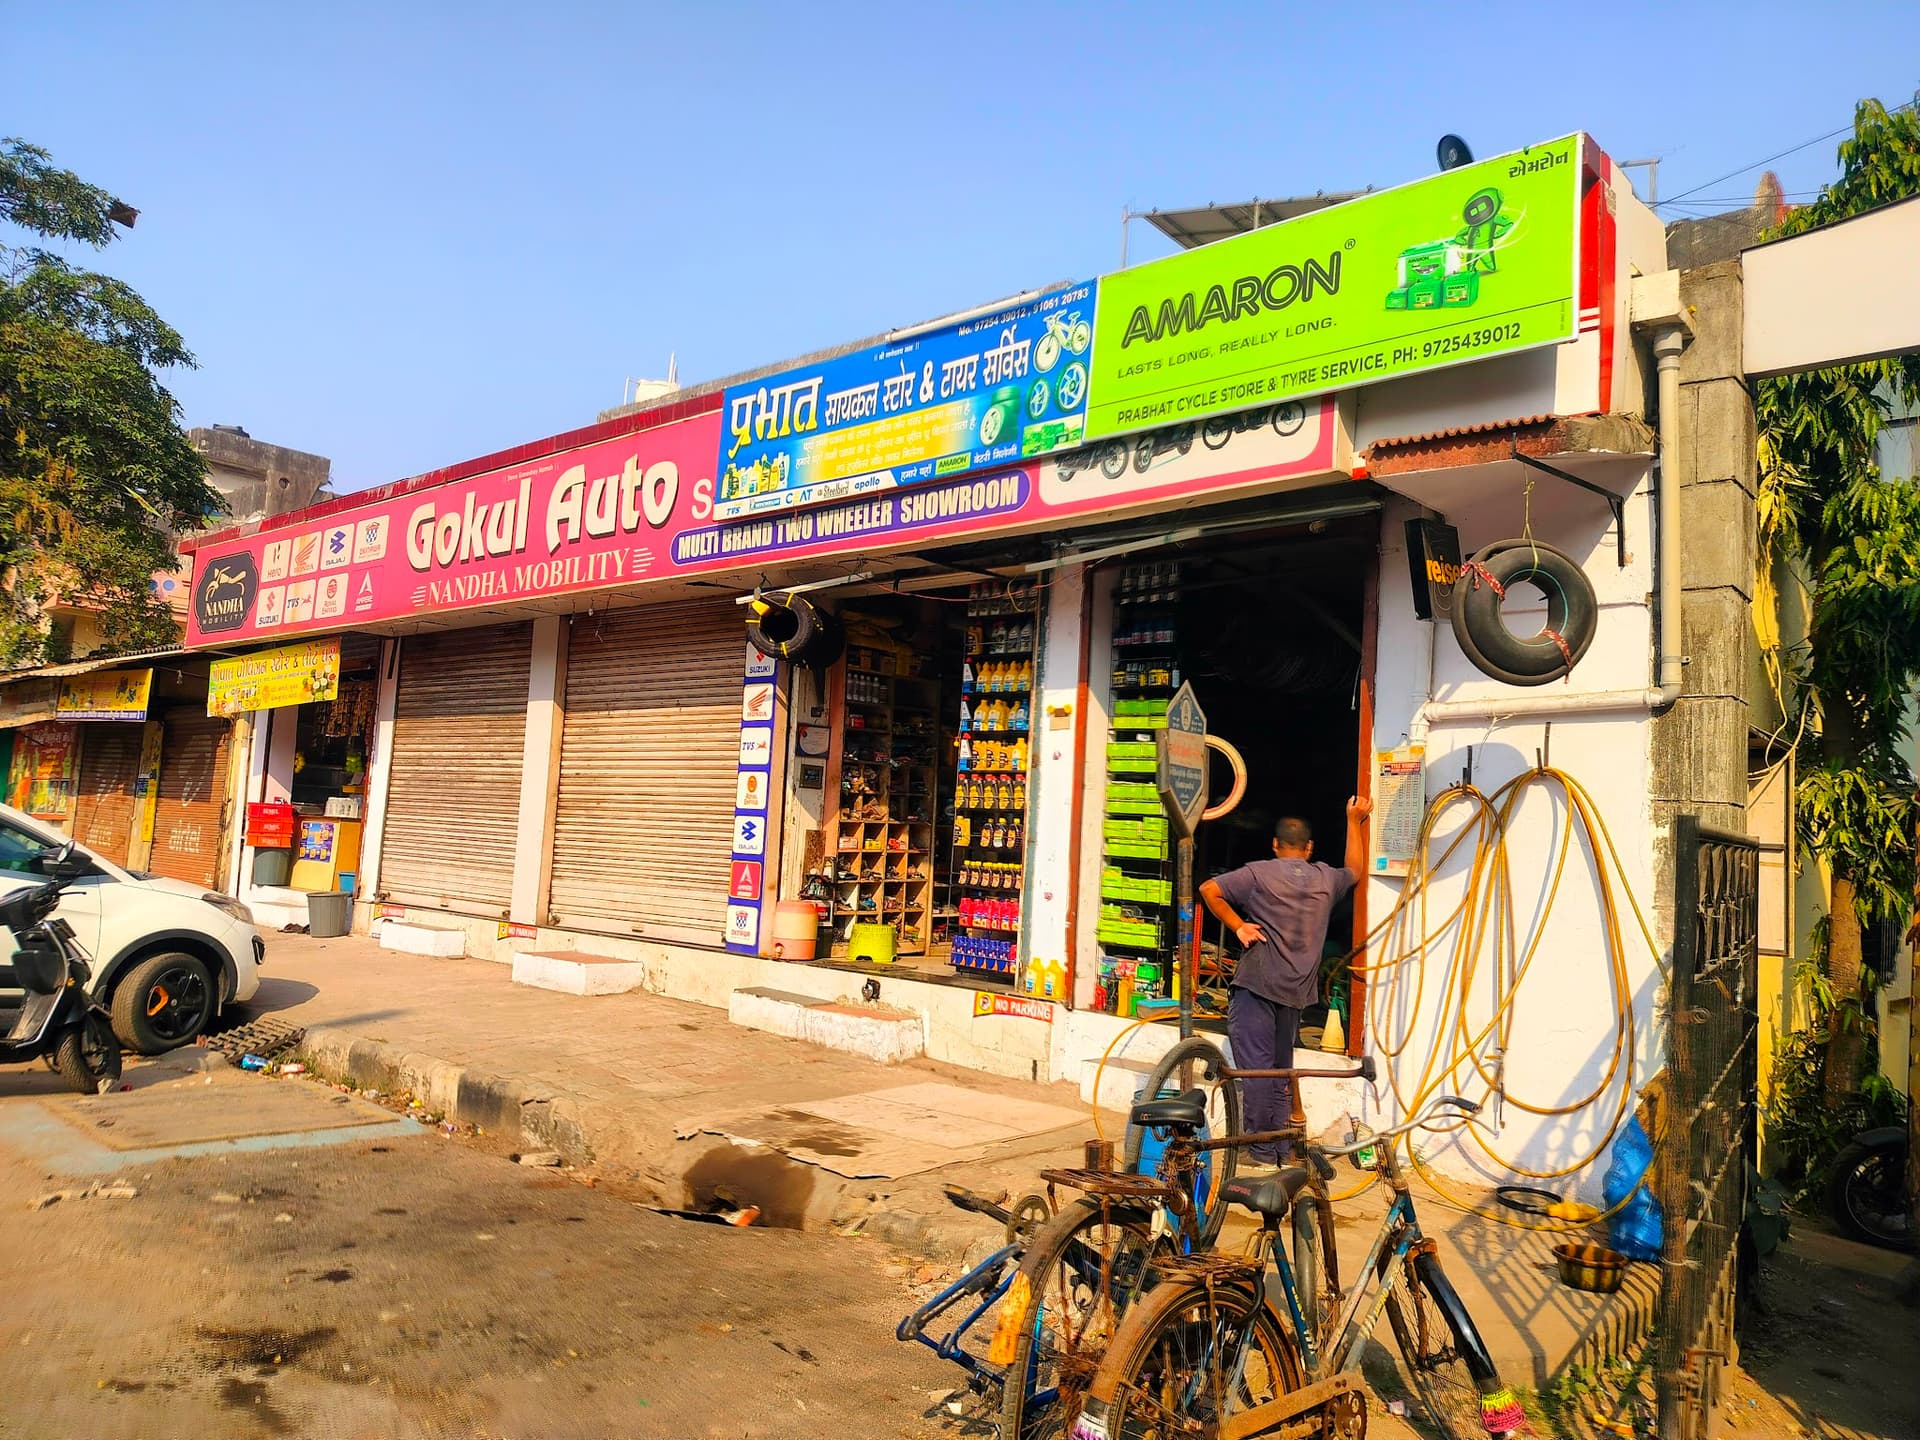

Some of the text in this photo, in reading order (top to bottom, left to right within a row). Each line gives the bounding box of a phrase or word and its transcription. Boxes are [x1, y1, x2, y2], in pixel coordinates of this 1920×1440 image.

[974, 316, 999, 332] 97254
[1061, 287, 1089, 305] 20783
[1121, 250, 1342, 350] AMARON
[1117, 317, 1338, 380] LASTS LONG, REALLY LONG.
[1116, 322, 1521, 426] PRABHAT CYCLE STORE & TYRE SERVICE, PH: 9725439012
[728, 377, 823, 460] प्रभात
[825, 382, 880, 427] सायकल
[882, 358, 917, 413] स्टोर
[919, 360, 934, 404] &
[940, 354, 980, 399] टायर
[982, 324, 1032, 387] सर्विस
[855, 477, 881, 491] apollo
[900, 467, 918, 482] हमारे
[406, 478, 532, 573] Gokul
[545, 453, 680, 557] Auto
[677, 475, 1020, 560] MULTI BRAND TWO WHEELER SHOWROOM
[726, 506, 741, 515] TVS
[427, 548, 632, 606] NANDHA MOBILITY
[1425, 554, 1461, 585] reise
[205, 597, 244, 617] NANDHA
[287, 598, 300, 609] TVS
[202, 613, 245, 626] MOBILITY
[259, 615, 279, 625] SUZUKI
[749, 665, 771, 674] SUZUKI
[742, 742, 755, 751] TVS
[995, 999, 1051, 1020] NO PARKING
